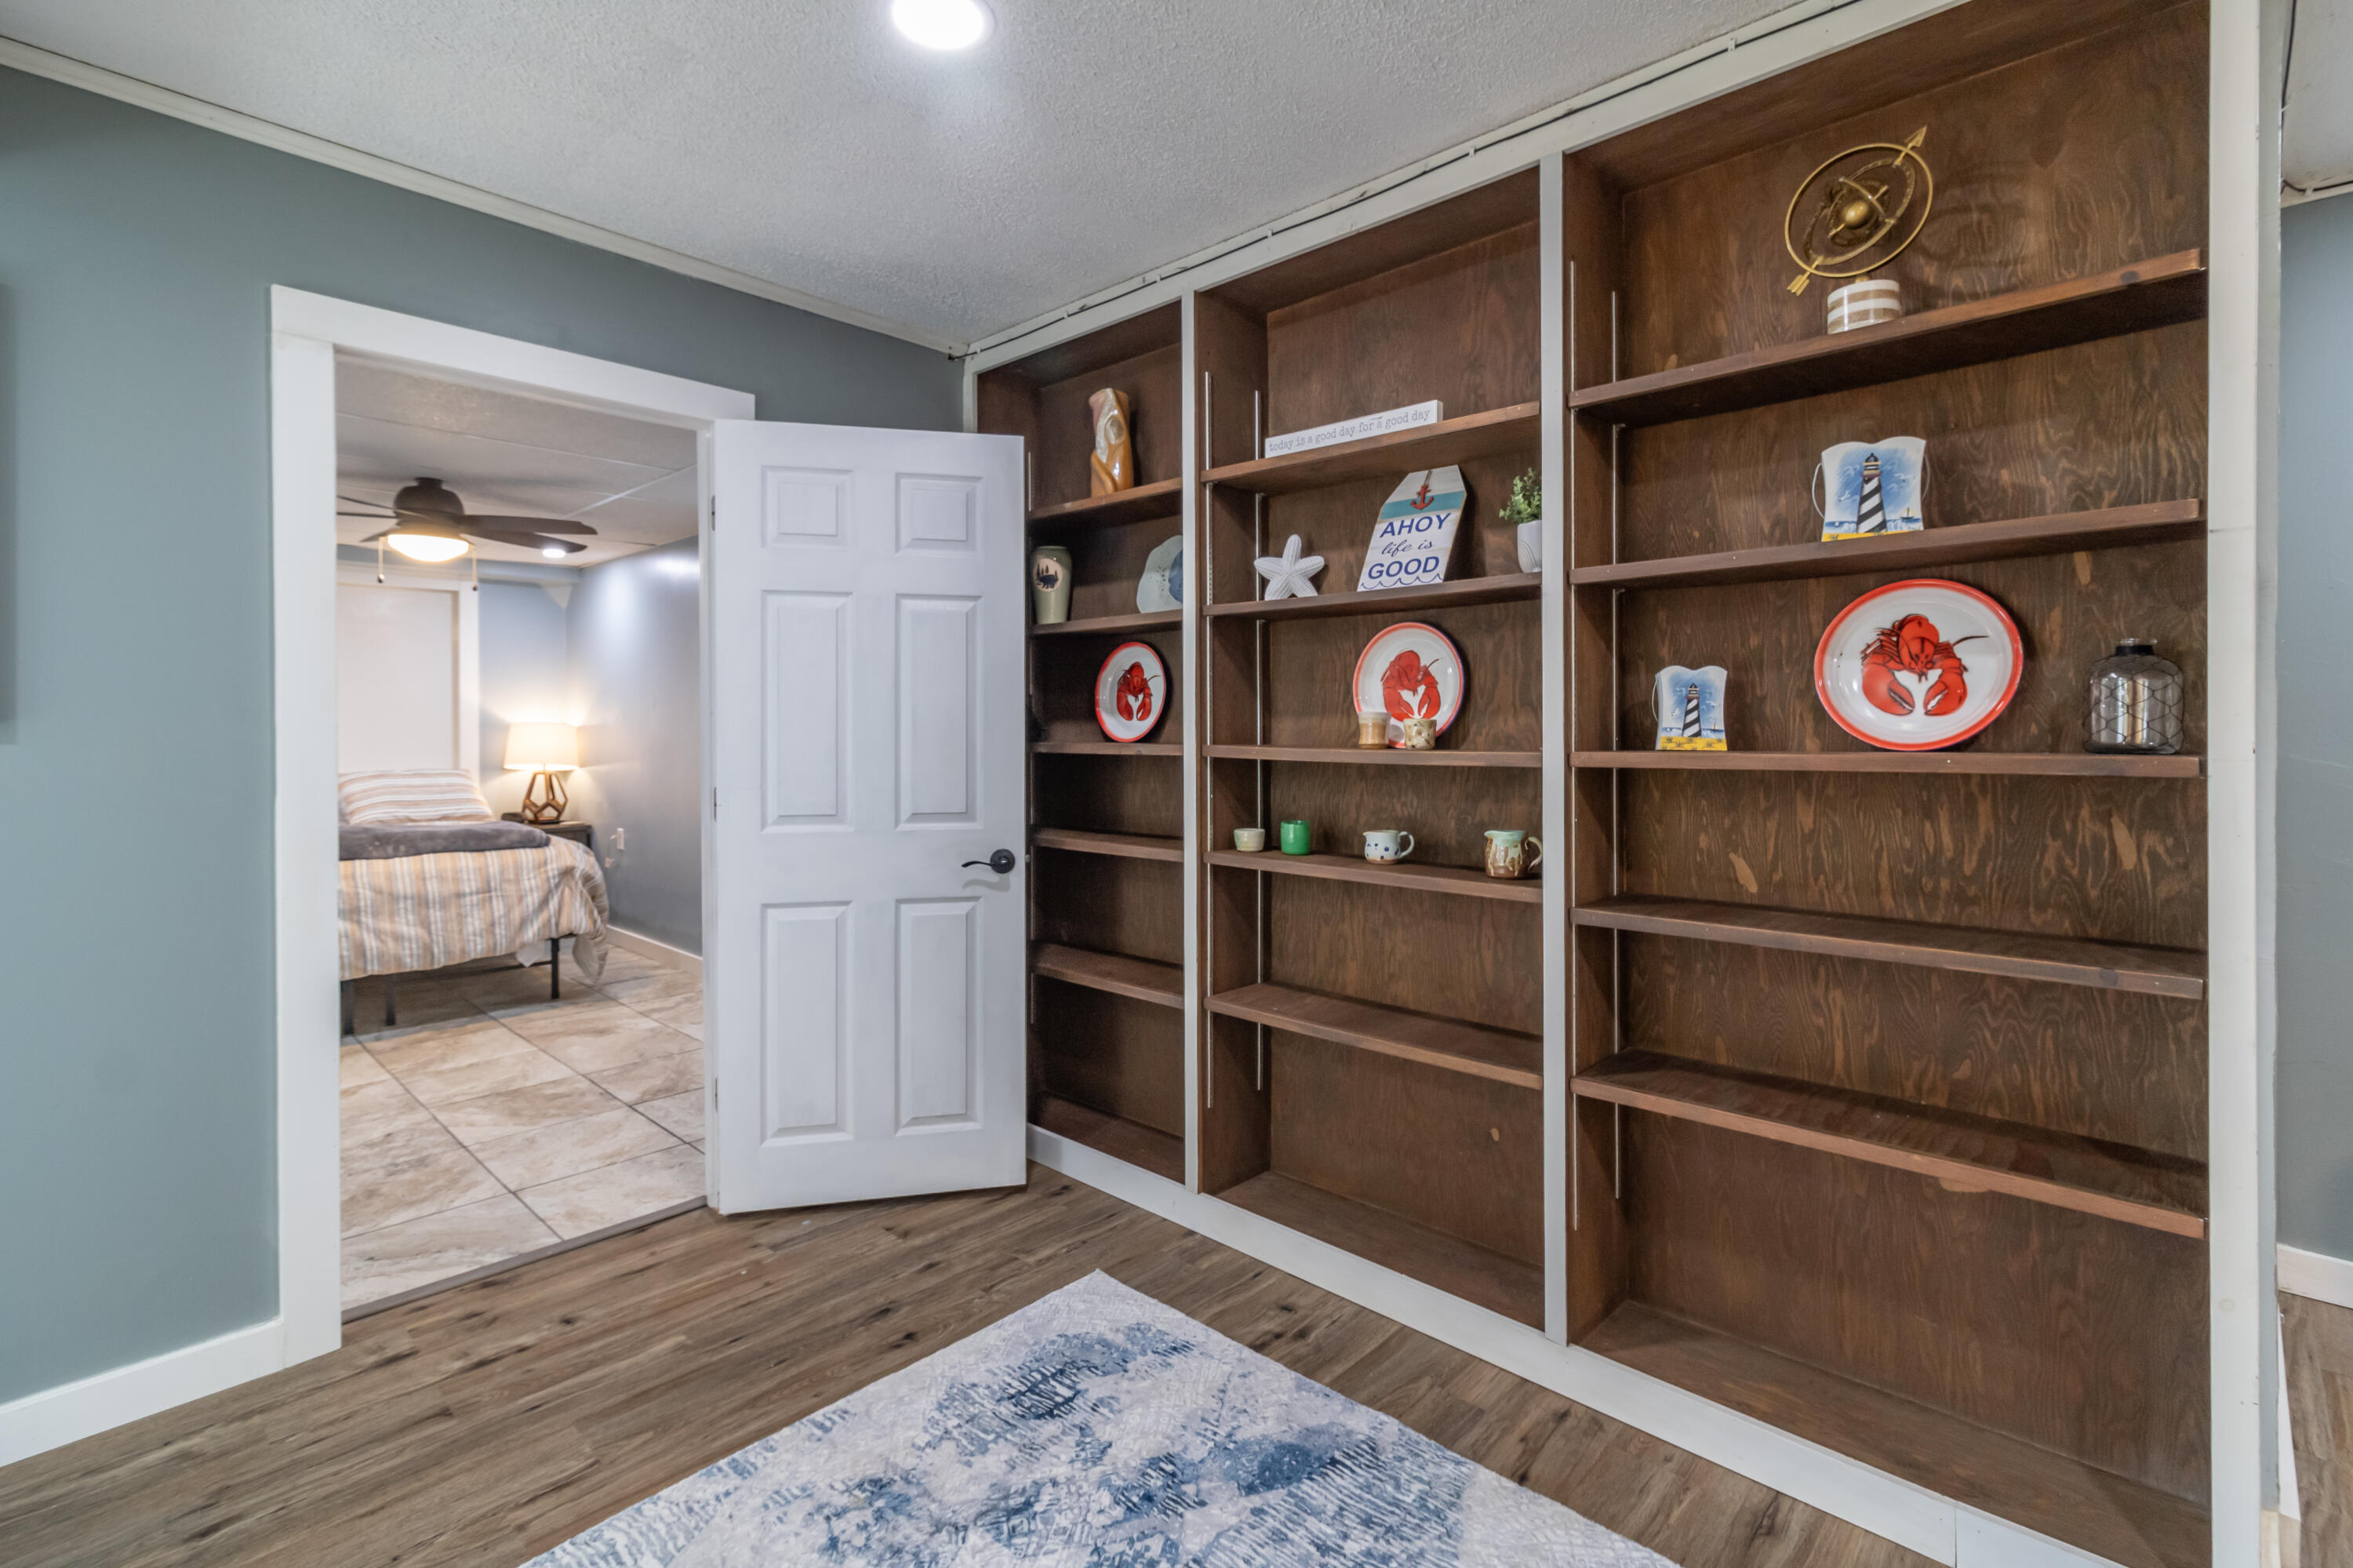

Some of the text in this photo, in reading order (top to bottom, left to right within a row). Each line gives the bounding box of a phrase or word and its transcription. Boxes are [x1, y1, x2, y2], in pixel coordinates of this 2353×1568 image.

[1269, 409, 1430, 452] today is a good day for a good day
[1380, 512, 1451, 538] AHOY
[1381, 539, 1432, 557] life is
[1368, 556, 1439, 580] GOOD
